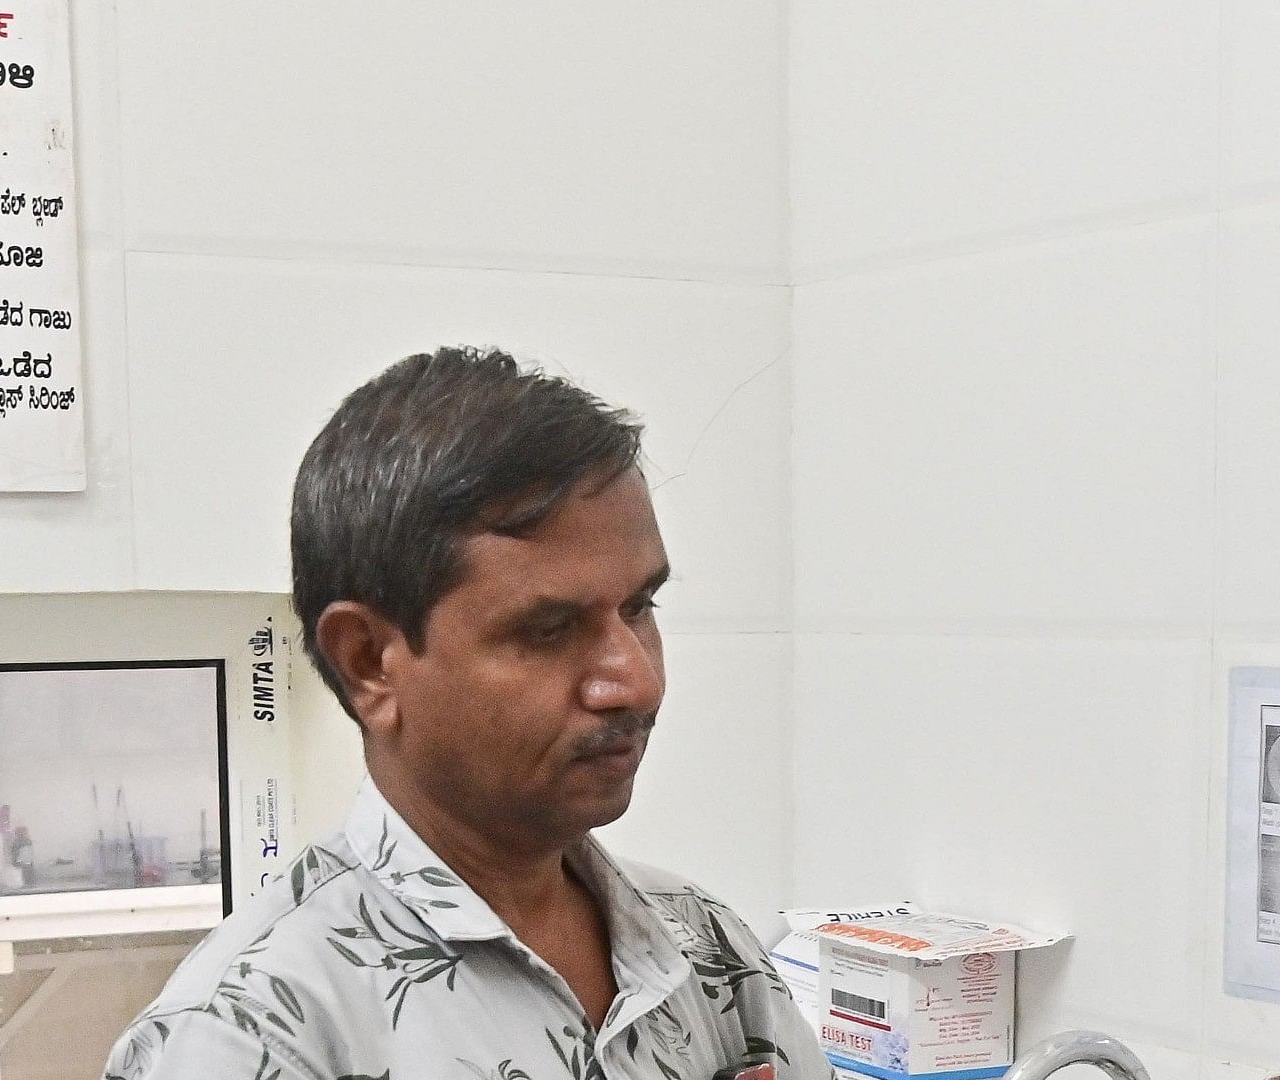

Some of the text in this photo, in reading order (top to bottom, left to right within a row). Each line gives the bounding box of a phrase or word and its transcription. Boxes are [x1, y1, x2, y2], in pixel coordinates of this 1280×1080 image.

[32, 196, 63, 227] ಬ್ಲೇಡ್
[29, 308, 72, 330] ಗಾಜು
[29, 385, 75, 410] ಸಿರಿಂಜ್
[253, 661, 275, 722] SIMTA
[821, 1025, 872, 1052] ELISA TEST
